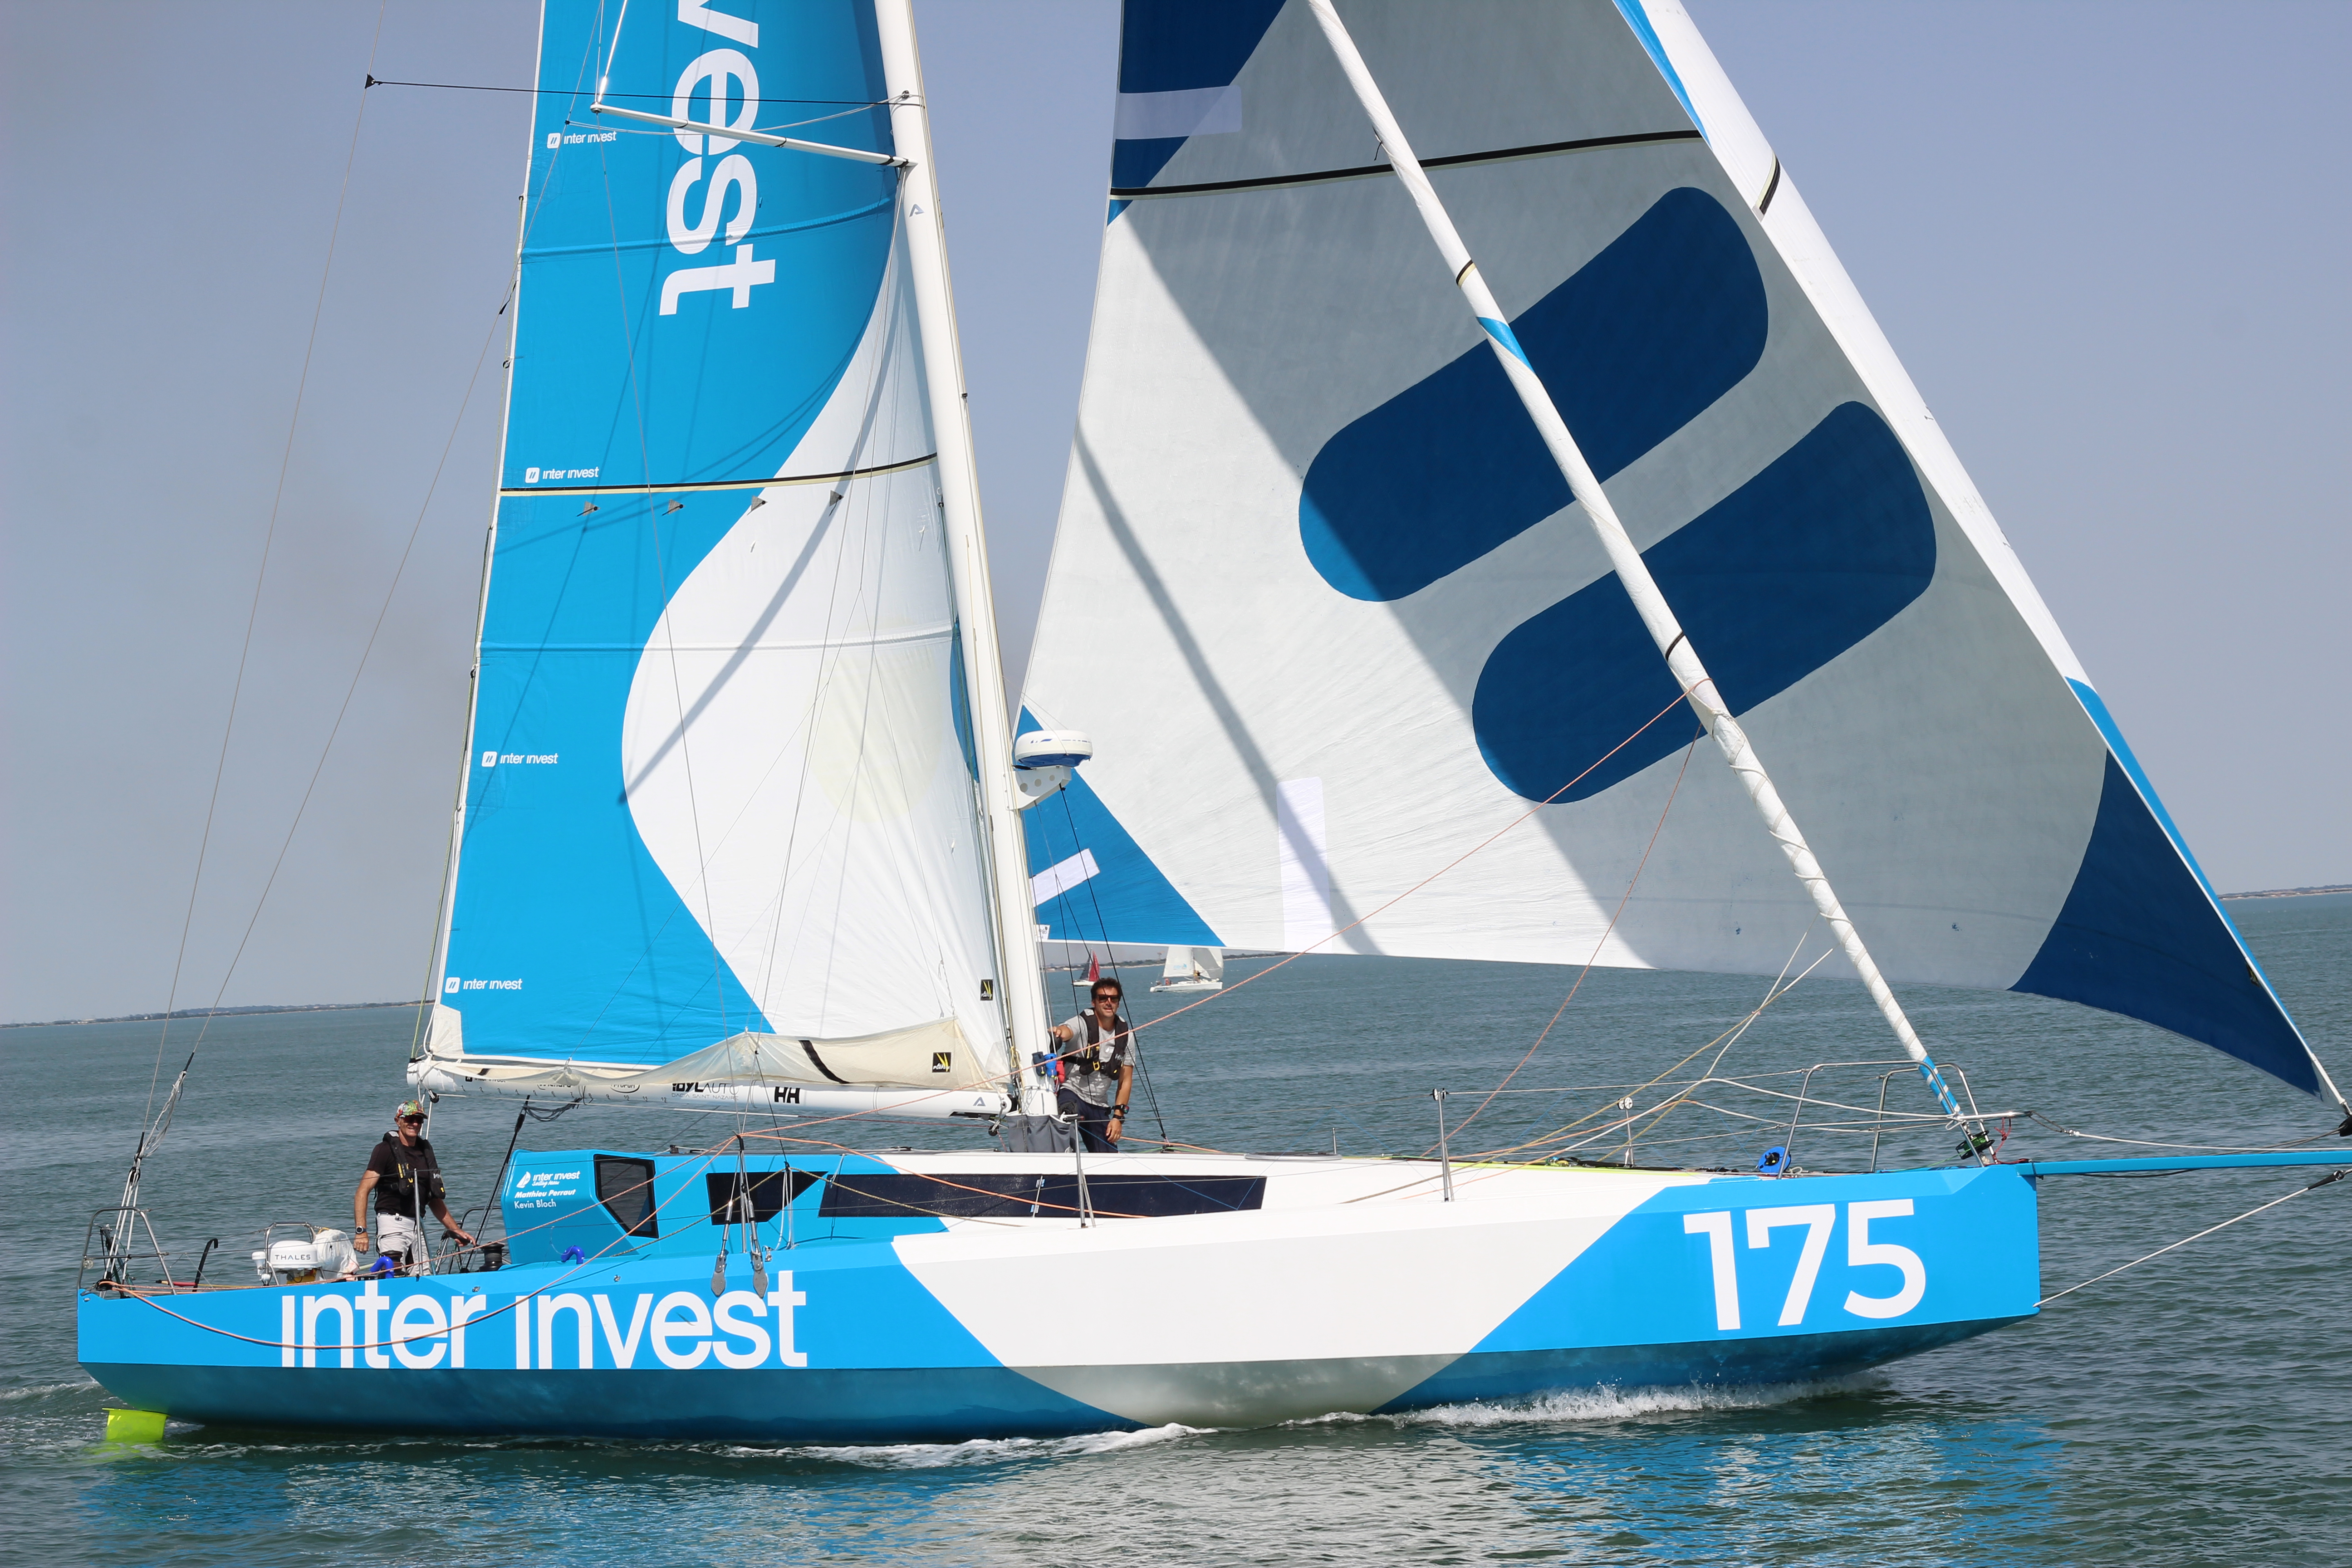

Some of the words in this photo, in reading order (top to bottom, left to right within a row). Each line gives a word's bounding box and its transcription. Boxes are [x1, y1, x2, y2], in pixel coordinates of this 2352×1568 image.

[564, 133, 587, 144] inter
[587, 131, 617, 143] invest
[543, 468, 566, 480] inter
[567, 466, 599, 479] invest
[500, 753, 525, 764] inter
[526, 753, 559, 764] invest
[463, 978, 488, 990] inter
[489, 978, 523, 990] invest
[774, 1086, 800, 1104] HH
[533, 1172, 554, 1181] inter
[554, 1171, 581, 1180] invest
[514, 1190, 548, 1199] Matthieu
[514, 1200, 534, 1209] Kevin
[536, 1199, 556, 1208] Bloch
[1683, 1199, 1926, 1331] 175
[281, 1280, 486, 1369] inter
[515, 1270, 808, 1369] invest
